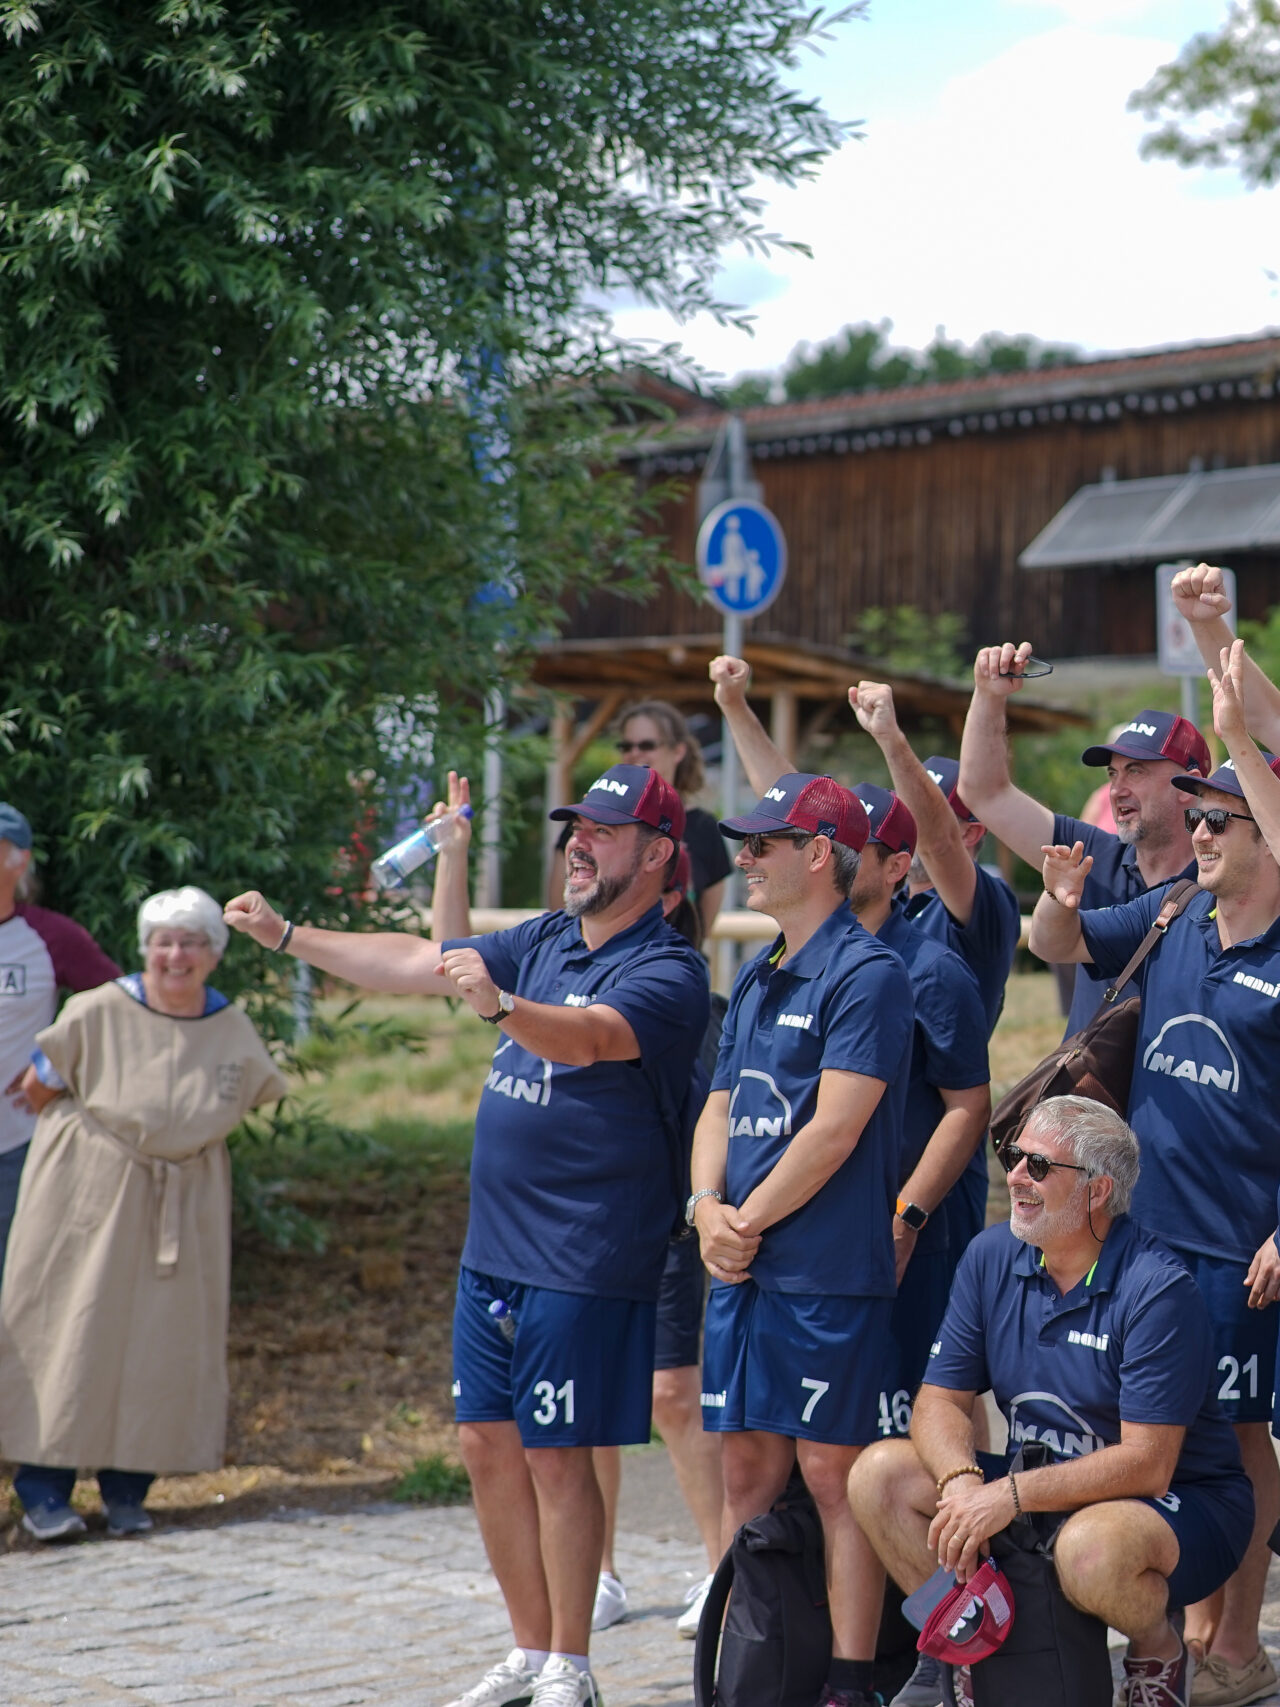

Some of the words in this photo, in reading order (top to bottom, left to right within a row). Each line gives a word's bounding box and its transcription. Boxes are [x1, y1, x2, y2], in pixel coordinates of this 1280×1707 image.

[1120, 722, 1157, 737] AN
[1148, 1052, 1233, 1091] MAN
[1217, 1354, 1258, 1400] 21
[533, 1379, 575, 1425] 31
[801, 1377, 830, 1423] 7
[1014, 1420, 1093, 1456] MAN
